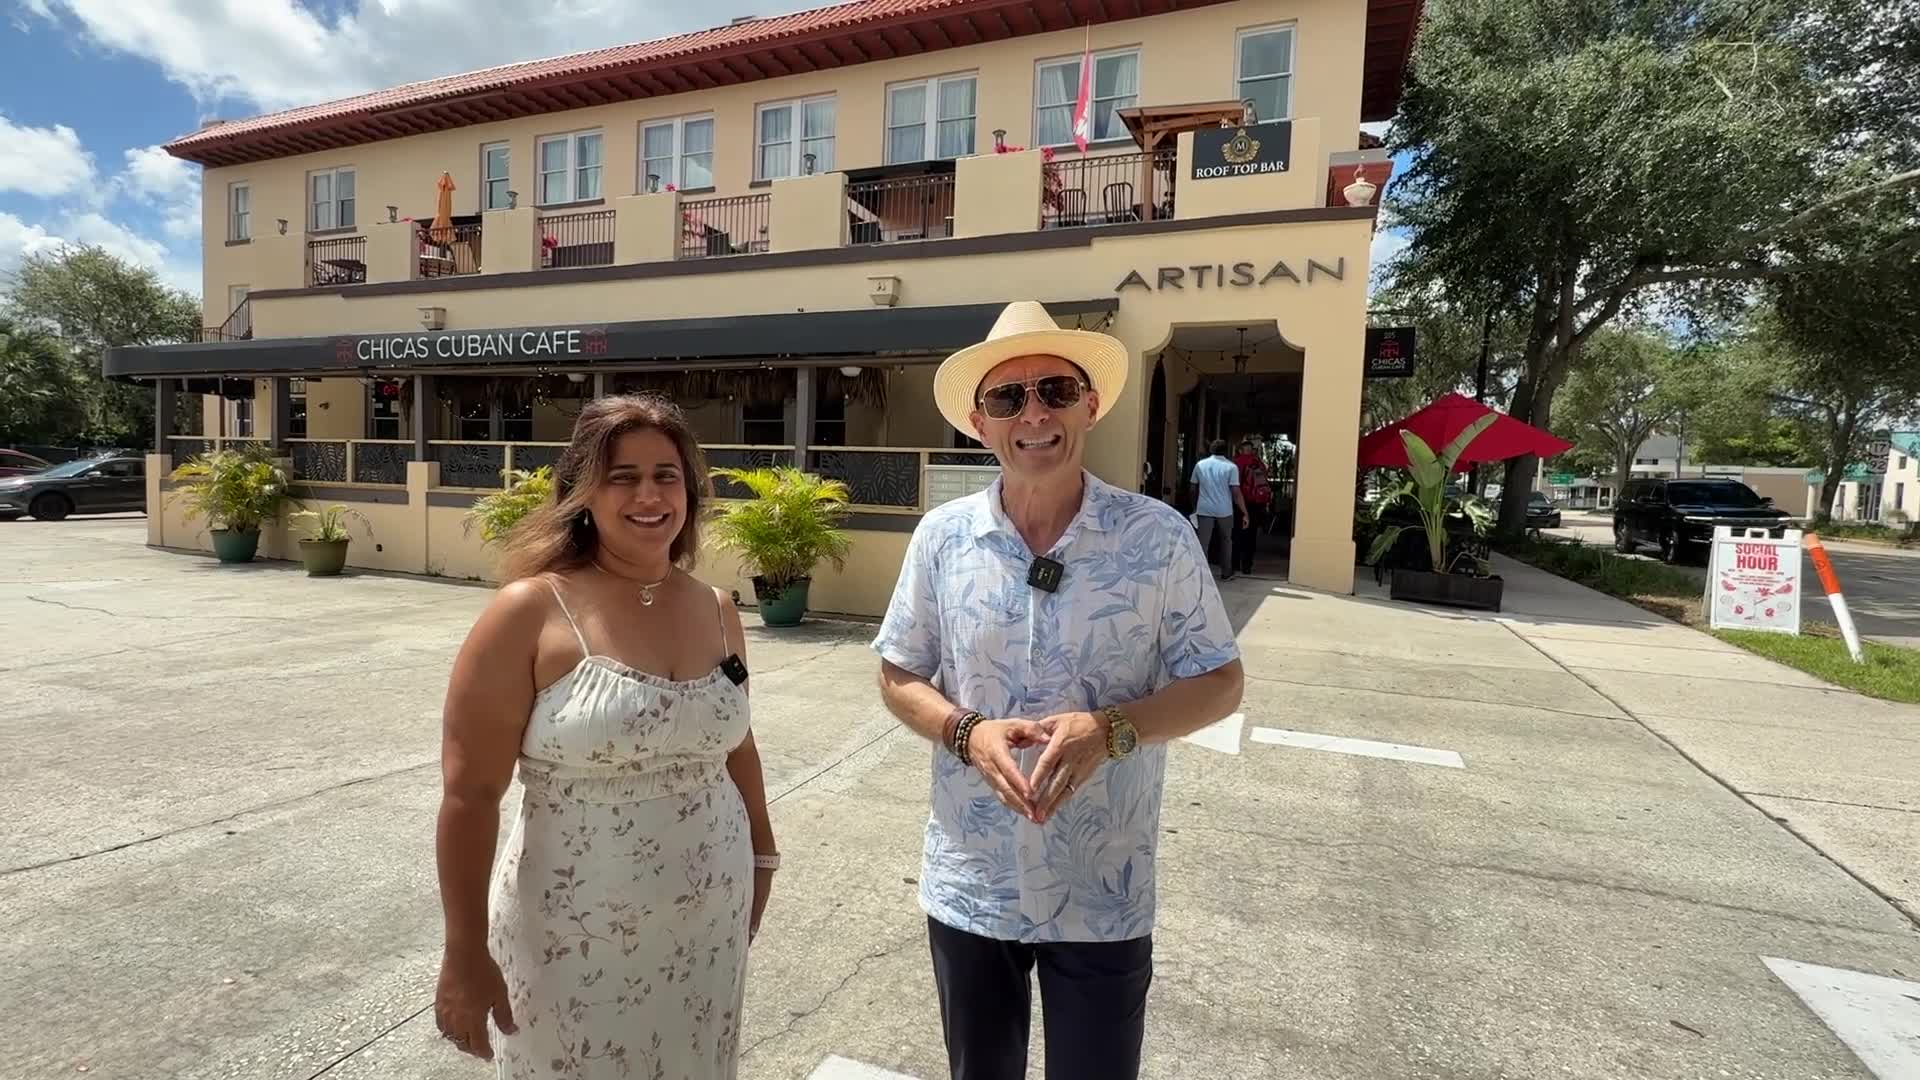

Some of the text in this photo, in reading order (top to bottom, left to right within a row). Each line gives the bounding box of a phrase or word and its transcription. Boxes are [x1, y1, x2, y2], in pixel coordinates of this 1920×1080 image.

[1196, 161, 1284, 178] ROOF TOP BAR
[1114, 256, 1344, 292] ARTISAN
[357, 330, 581, 360] CHICAS CUBAN CAFE
[1371, 357, 1406, 365] CHICAS
[1874, 443, 1887, 453] 17
[1870, 460, 1886, 470] 92
[1735, 543, 1779, 556] SOCIAL
[1736, 555, 1778, 571] HOUR
